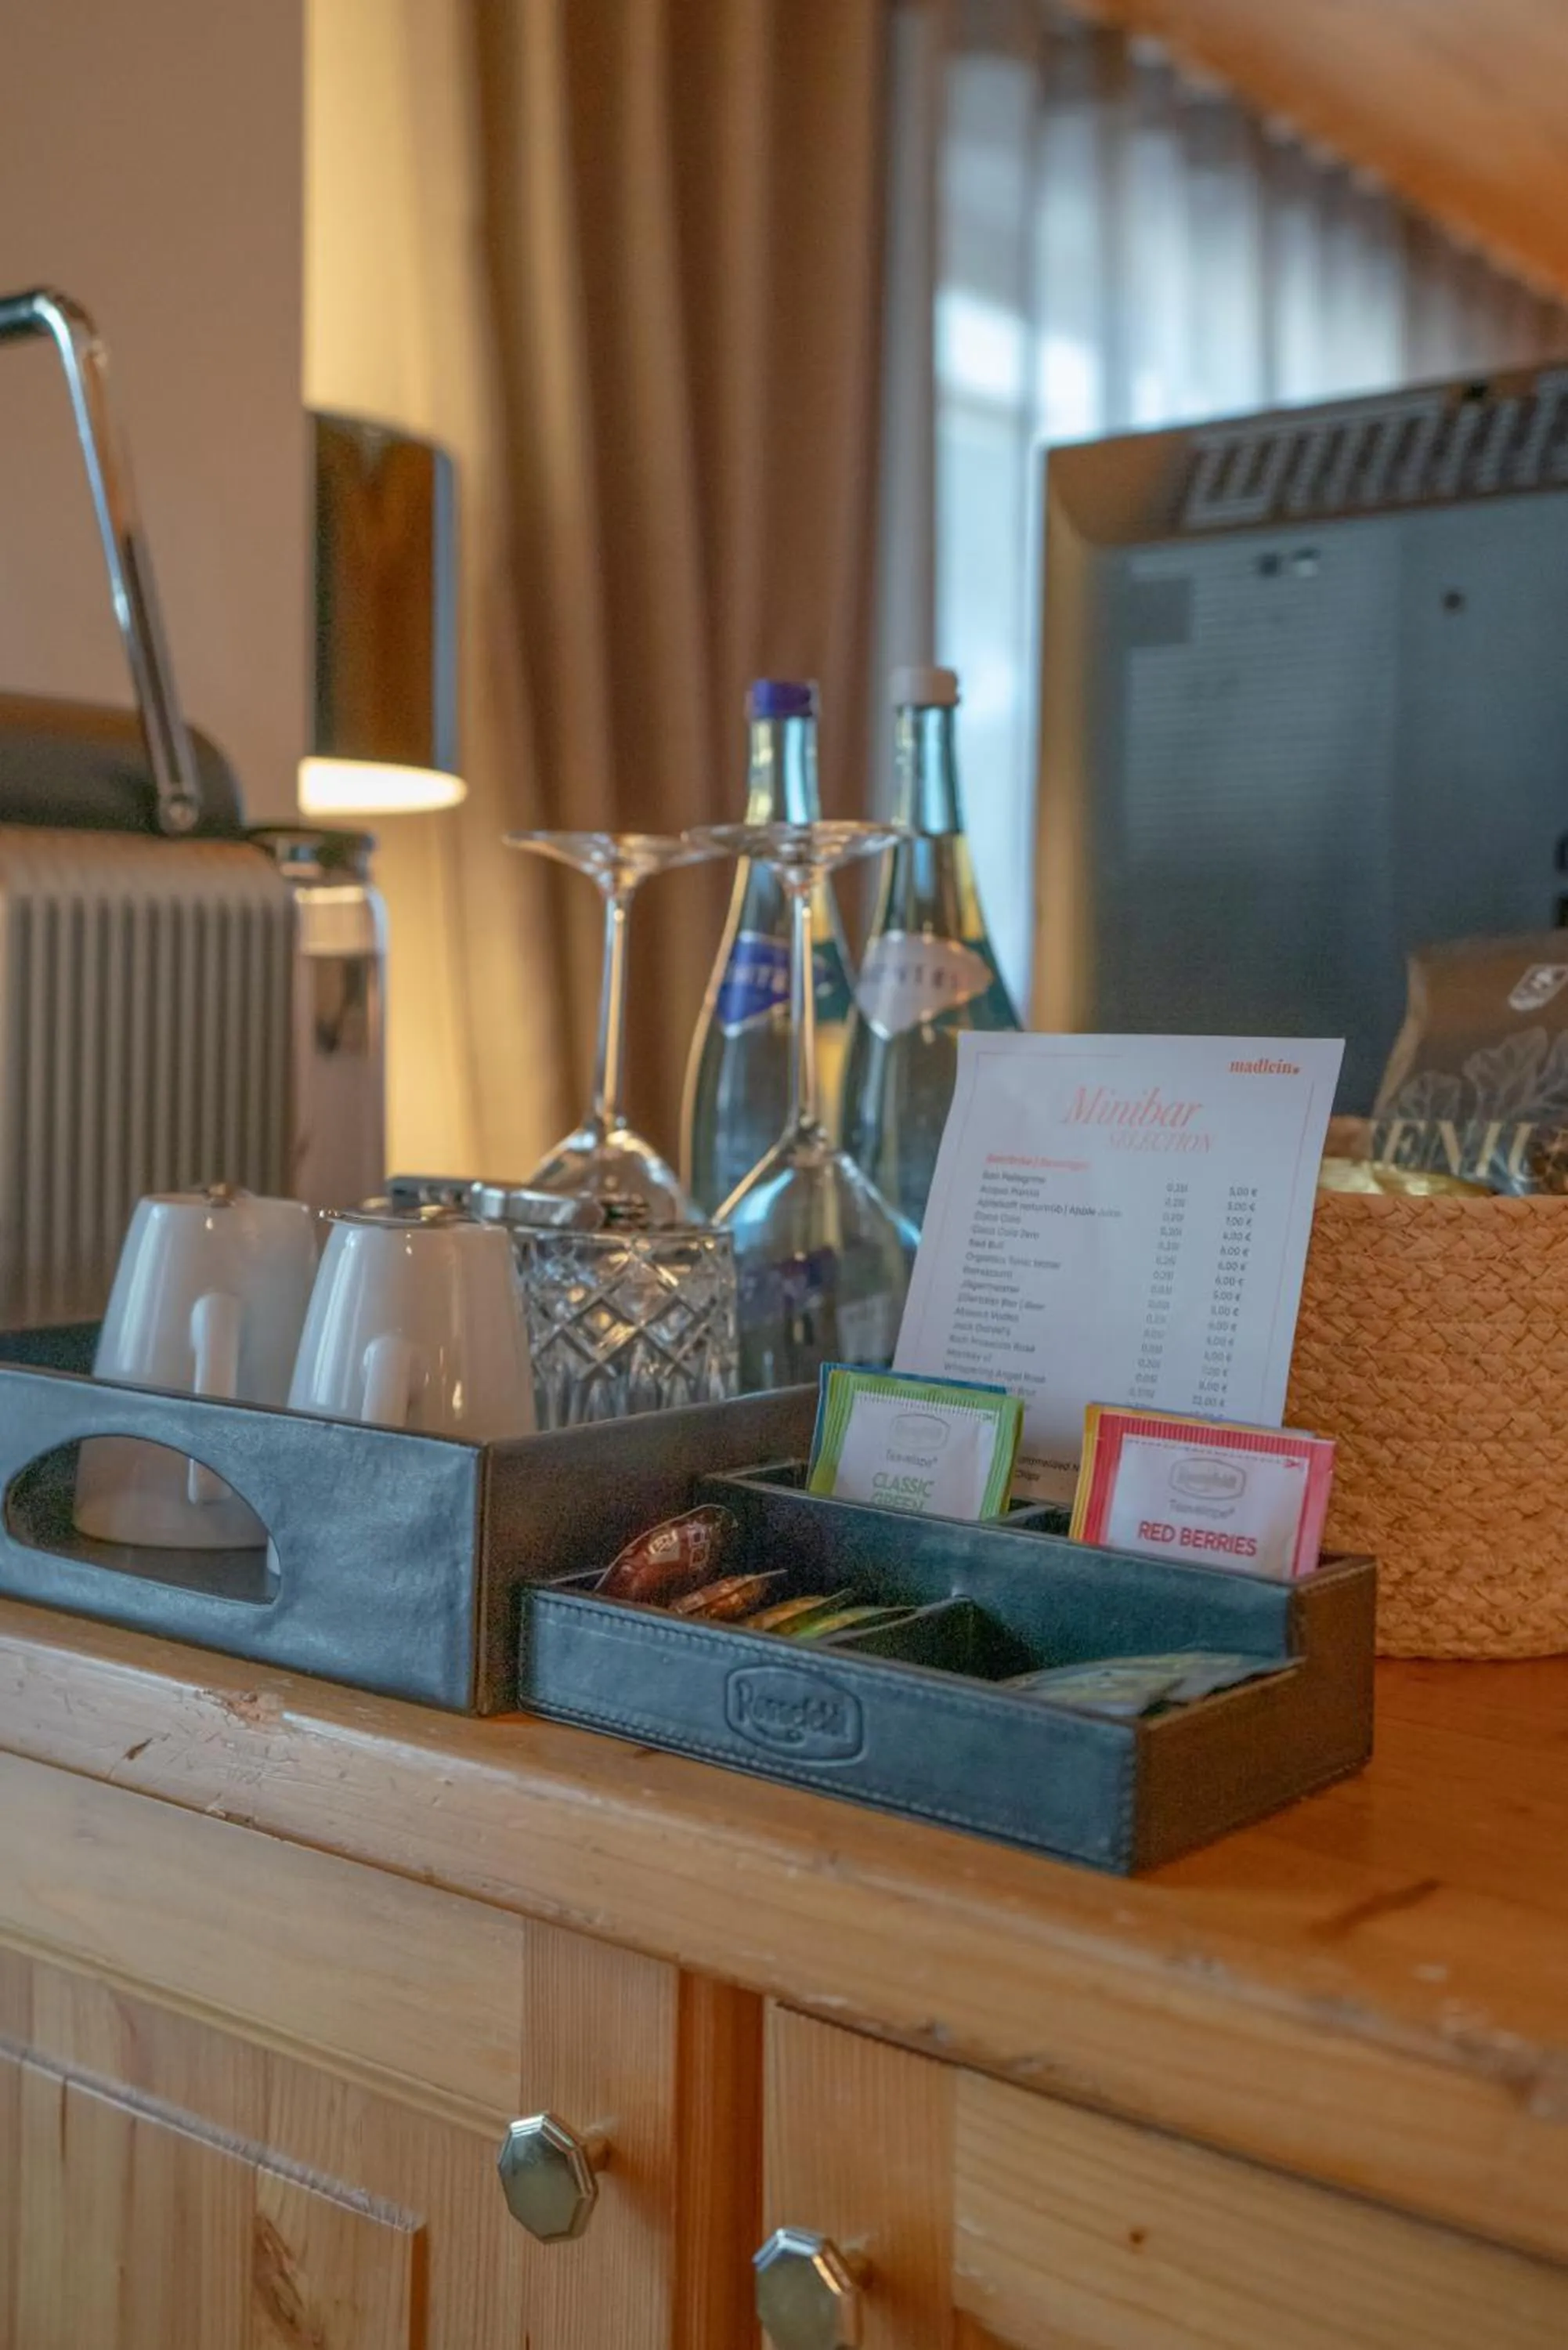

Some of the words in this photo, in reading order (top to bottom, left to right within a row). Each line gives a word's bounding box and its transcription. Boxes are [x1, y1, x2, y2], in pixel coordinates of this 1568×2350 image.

[1060, 1084, 1205, 1127] Minibar
[871, 1471, 935, 1498] CLASSIC
[1137, 1521, 1176, 1543] RED
[1179, 1527, 1258, 1557] BERRIES
